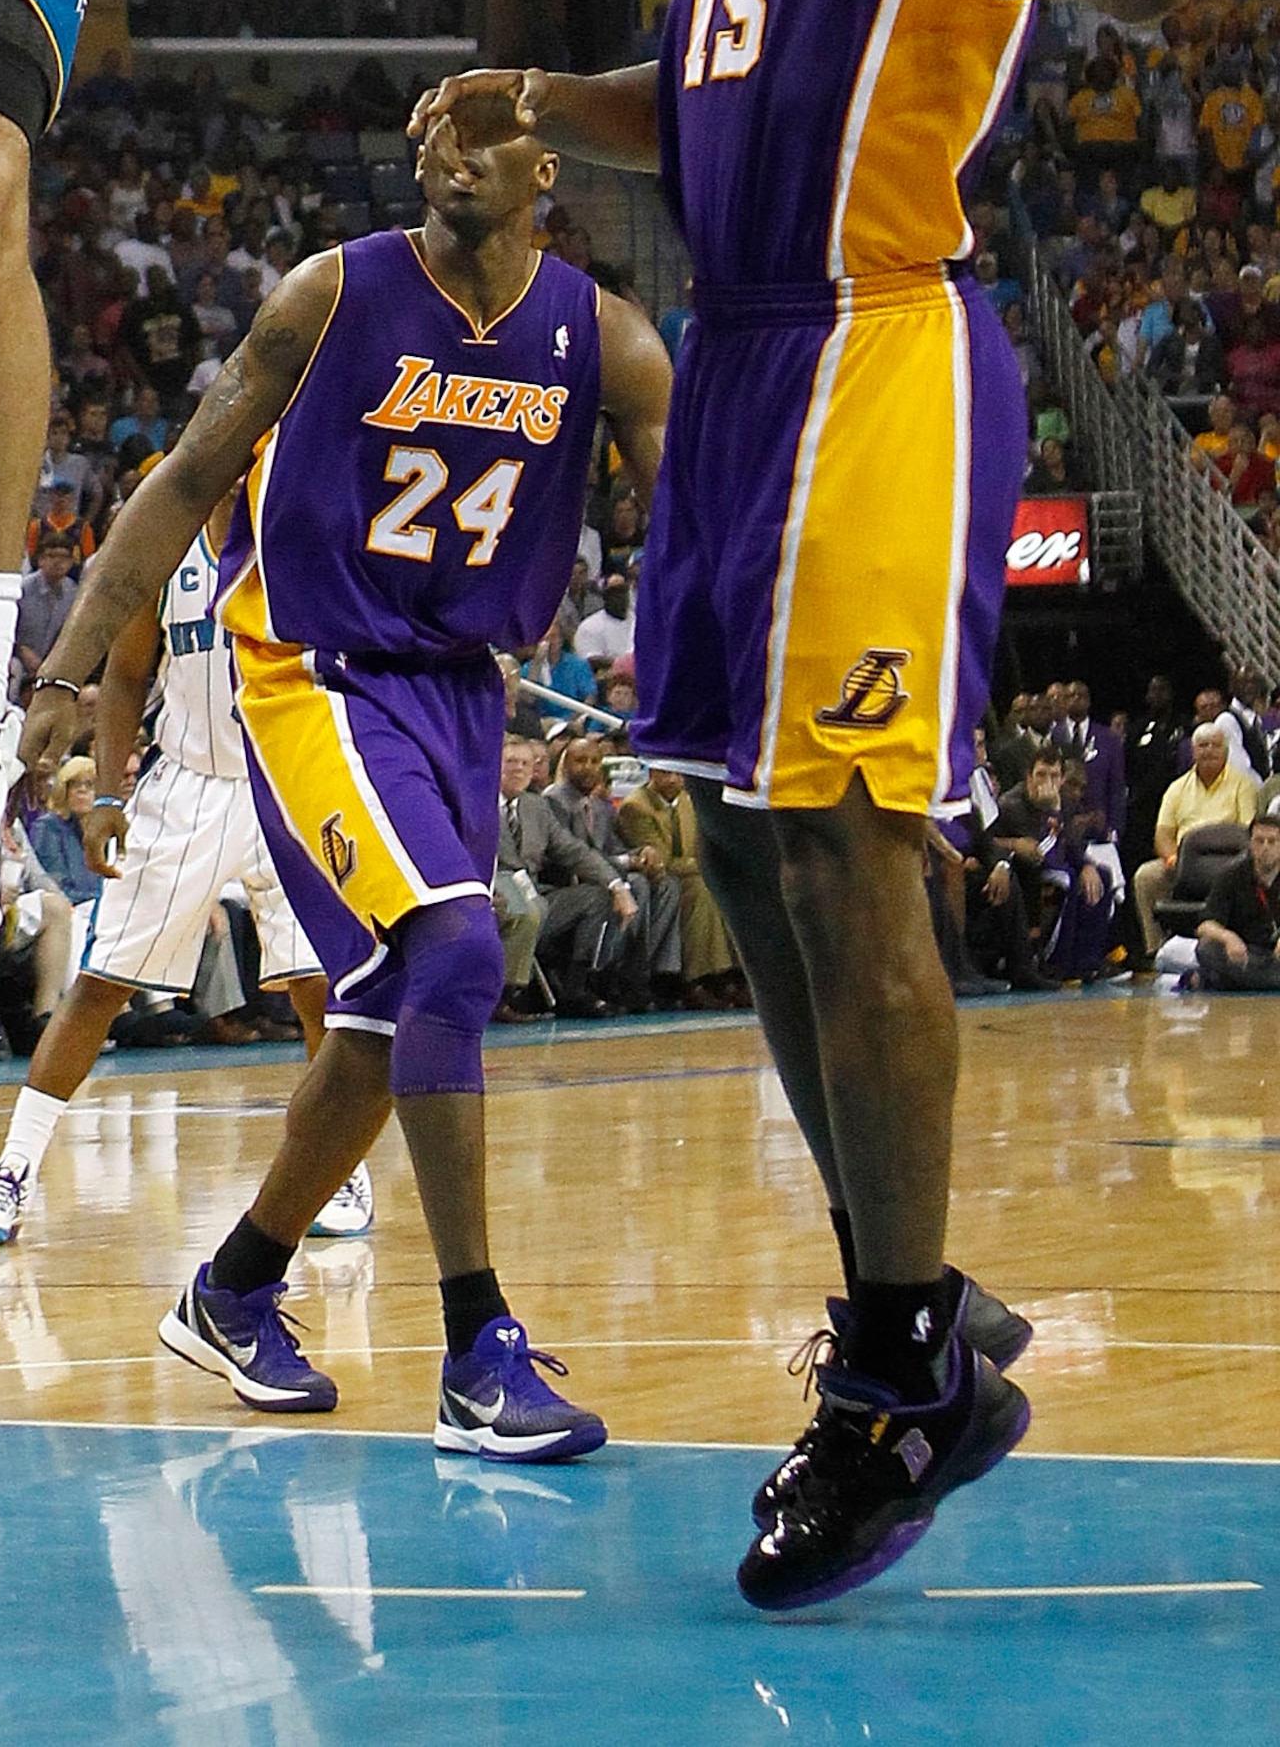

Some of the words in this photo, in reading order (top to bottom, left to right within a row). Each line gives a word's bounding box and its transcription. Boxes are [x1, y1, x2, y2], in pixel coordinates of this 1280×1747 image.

[361, 355, 570, 445] LAKERS
[365, 444, 525, 567] 24
[180, 566, 200, 592] C
